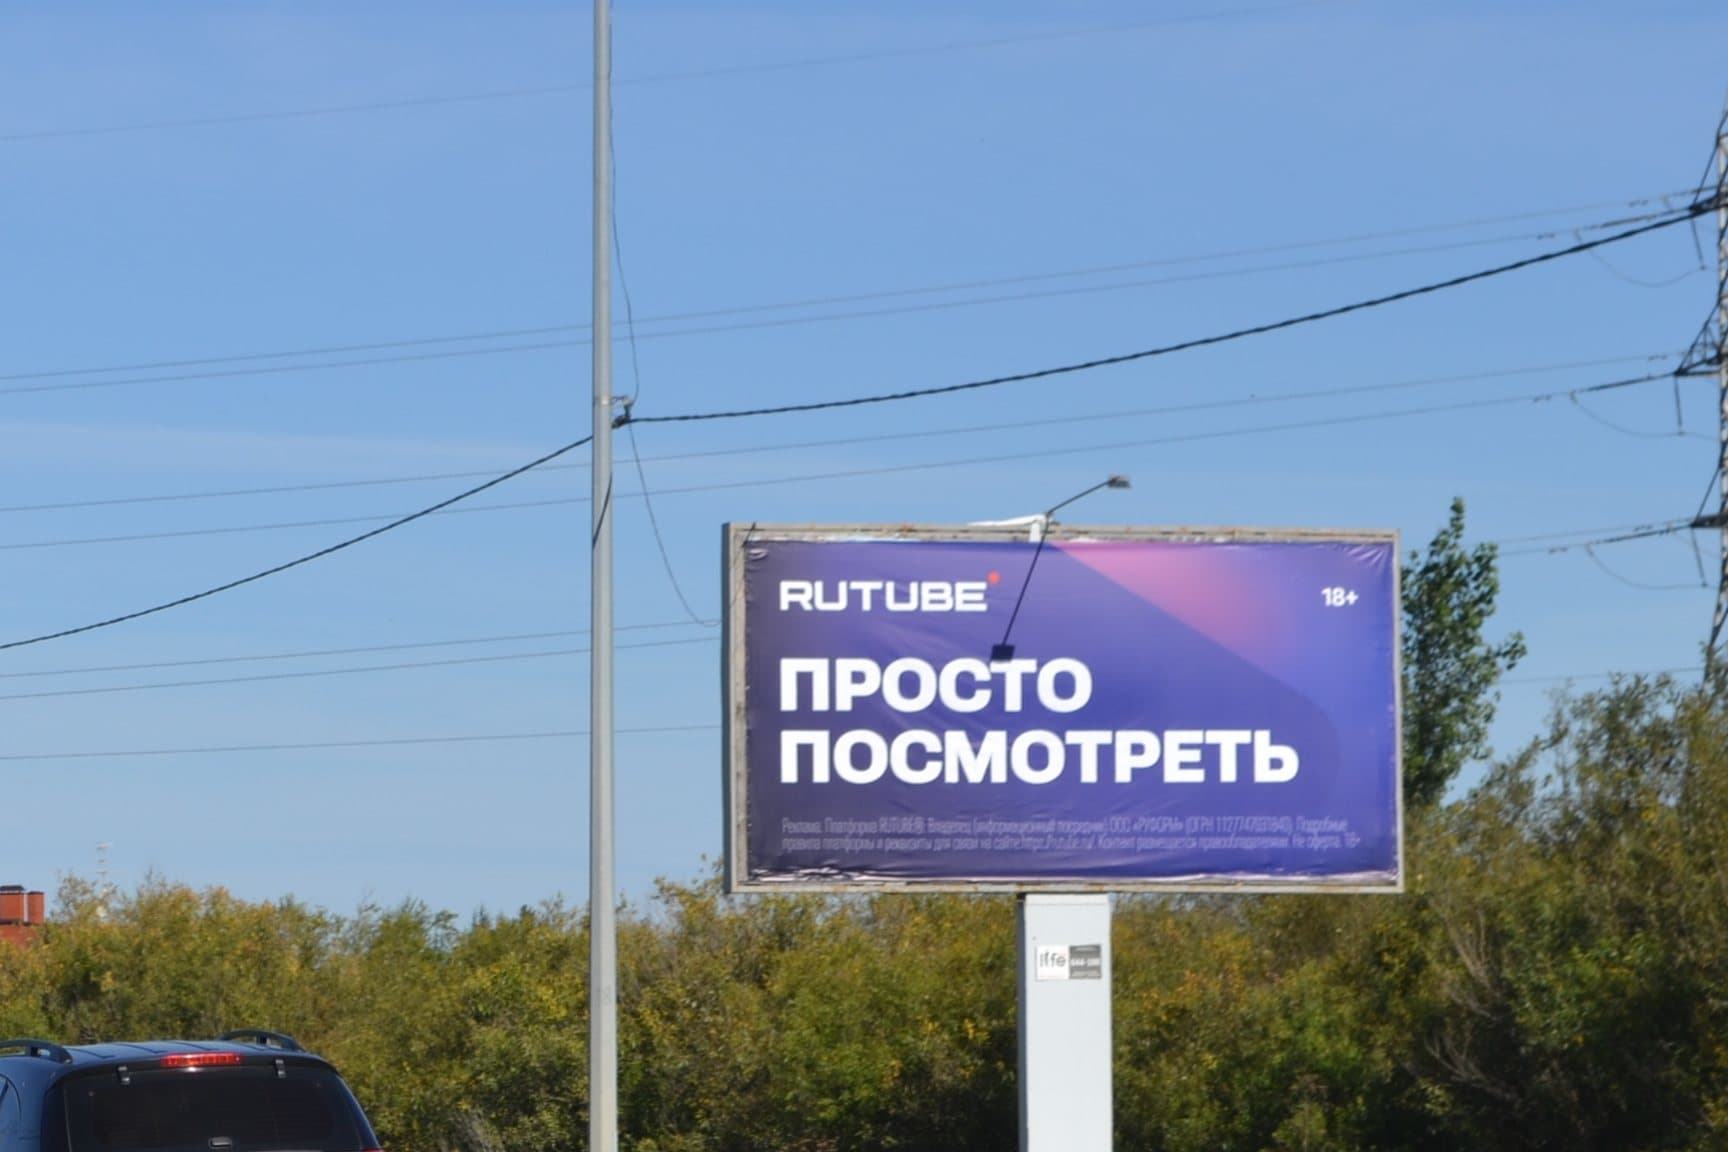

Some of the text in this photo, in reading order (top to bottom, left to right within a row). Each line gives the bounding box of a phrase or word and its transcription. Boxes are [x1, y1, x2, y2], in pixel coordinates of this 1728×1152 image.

[779, 580, 989, 612] RUTUBE
[1321, 587, 1359, 607] 18+
[780, 657, 1092, 713] ПРОСТО
[780, 729, 1300, 784] ПОСМОТРЕТЬ
